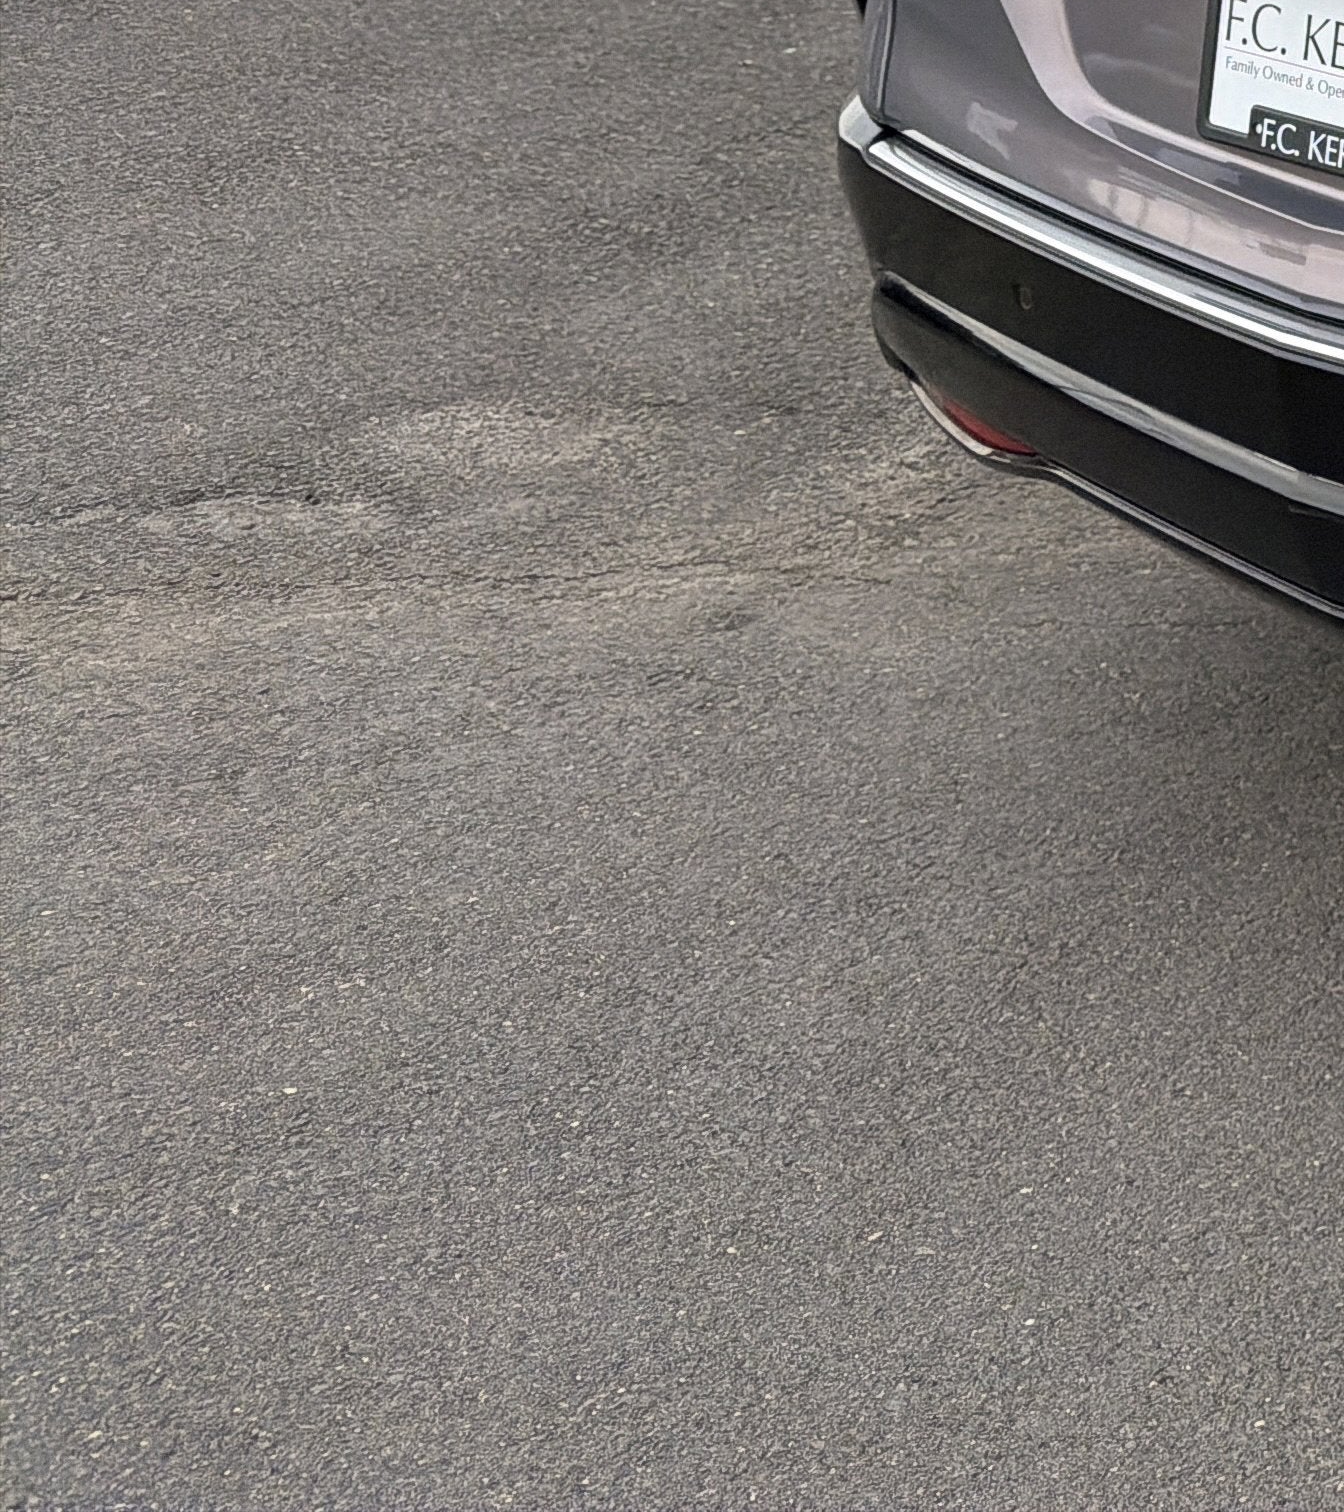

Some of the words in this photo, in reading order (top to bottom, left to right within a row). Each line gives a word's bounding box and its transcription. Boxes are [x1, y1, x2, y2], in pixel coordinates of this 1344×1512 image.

[1225, 55, 1261, 79] Family
[1262, 65, 1304, 88] Owned
[1306, 76, 1315, 91] &
[1260, 117, 1300, 157] F.C.
